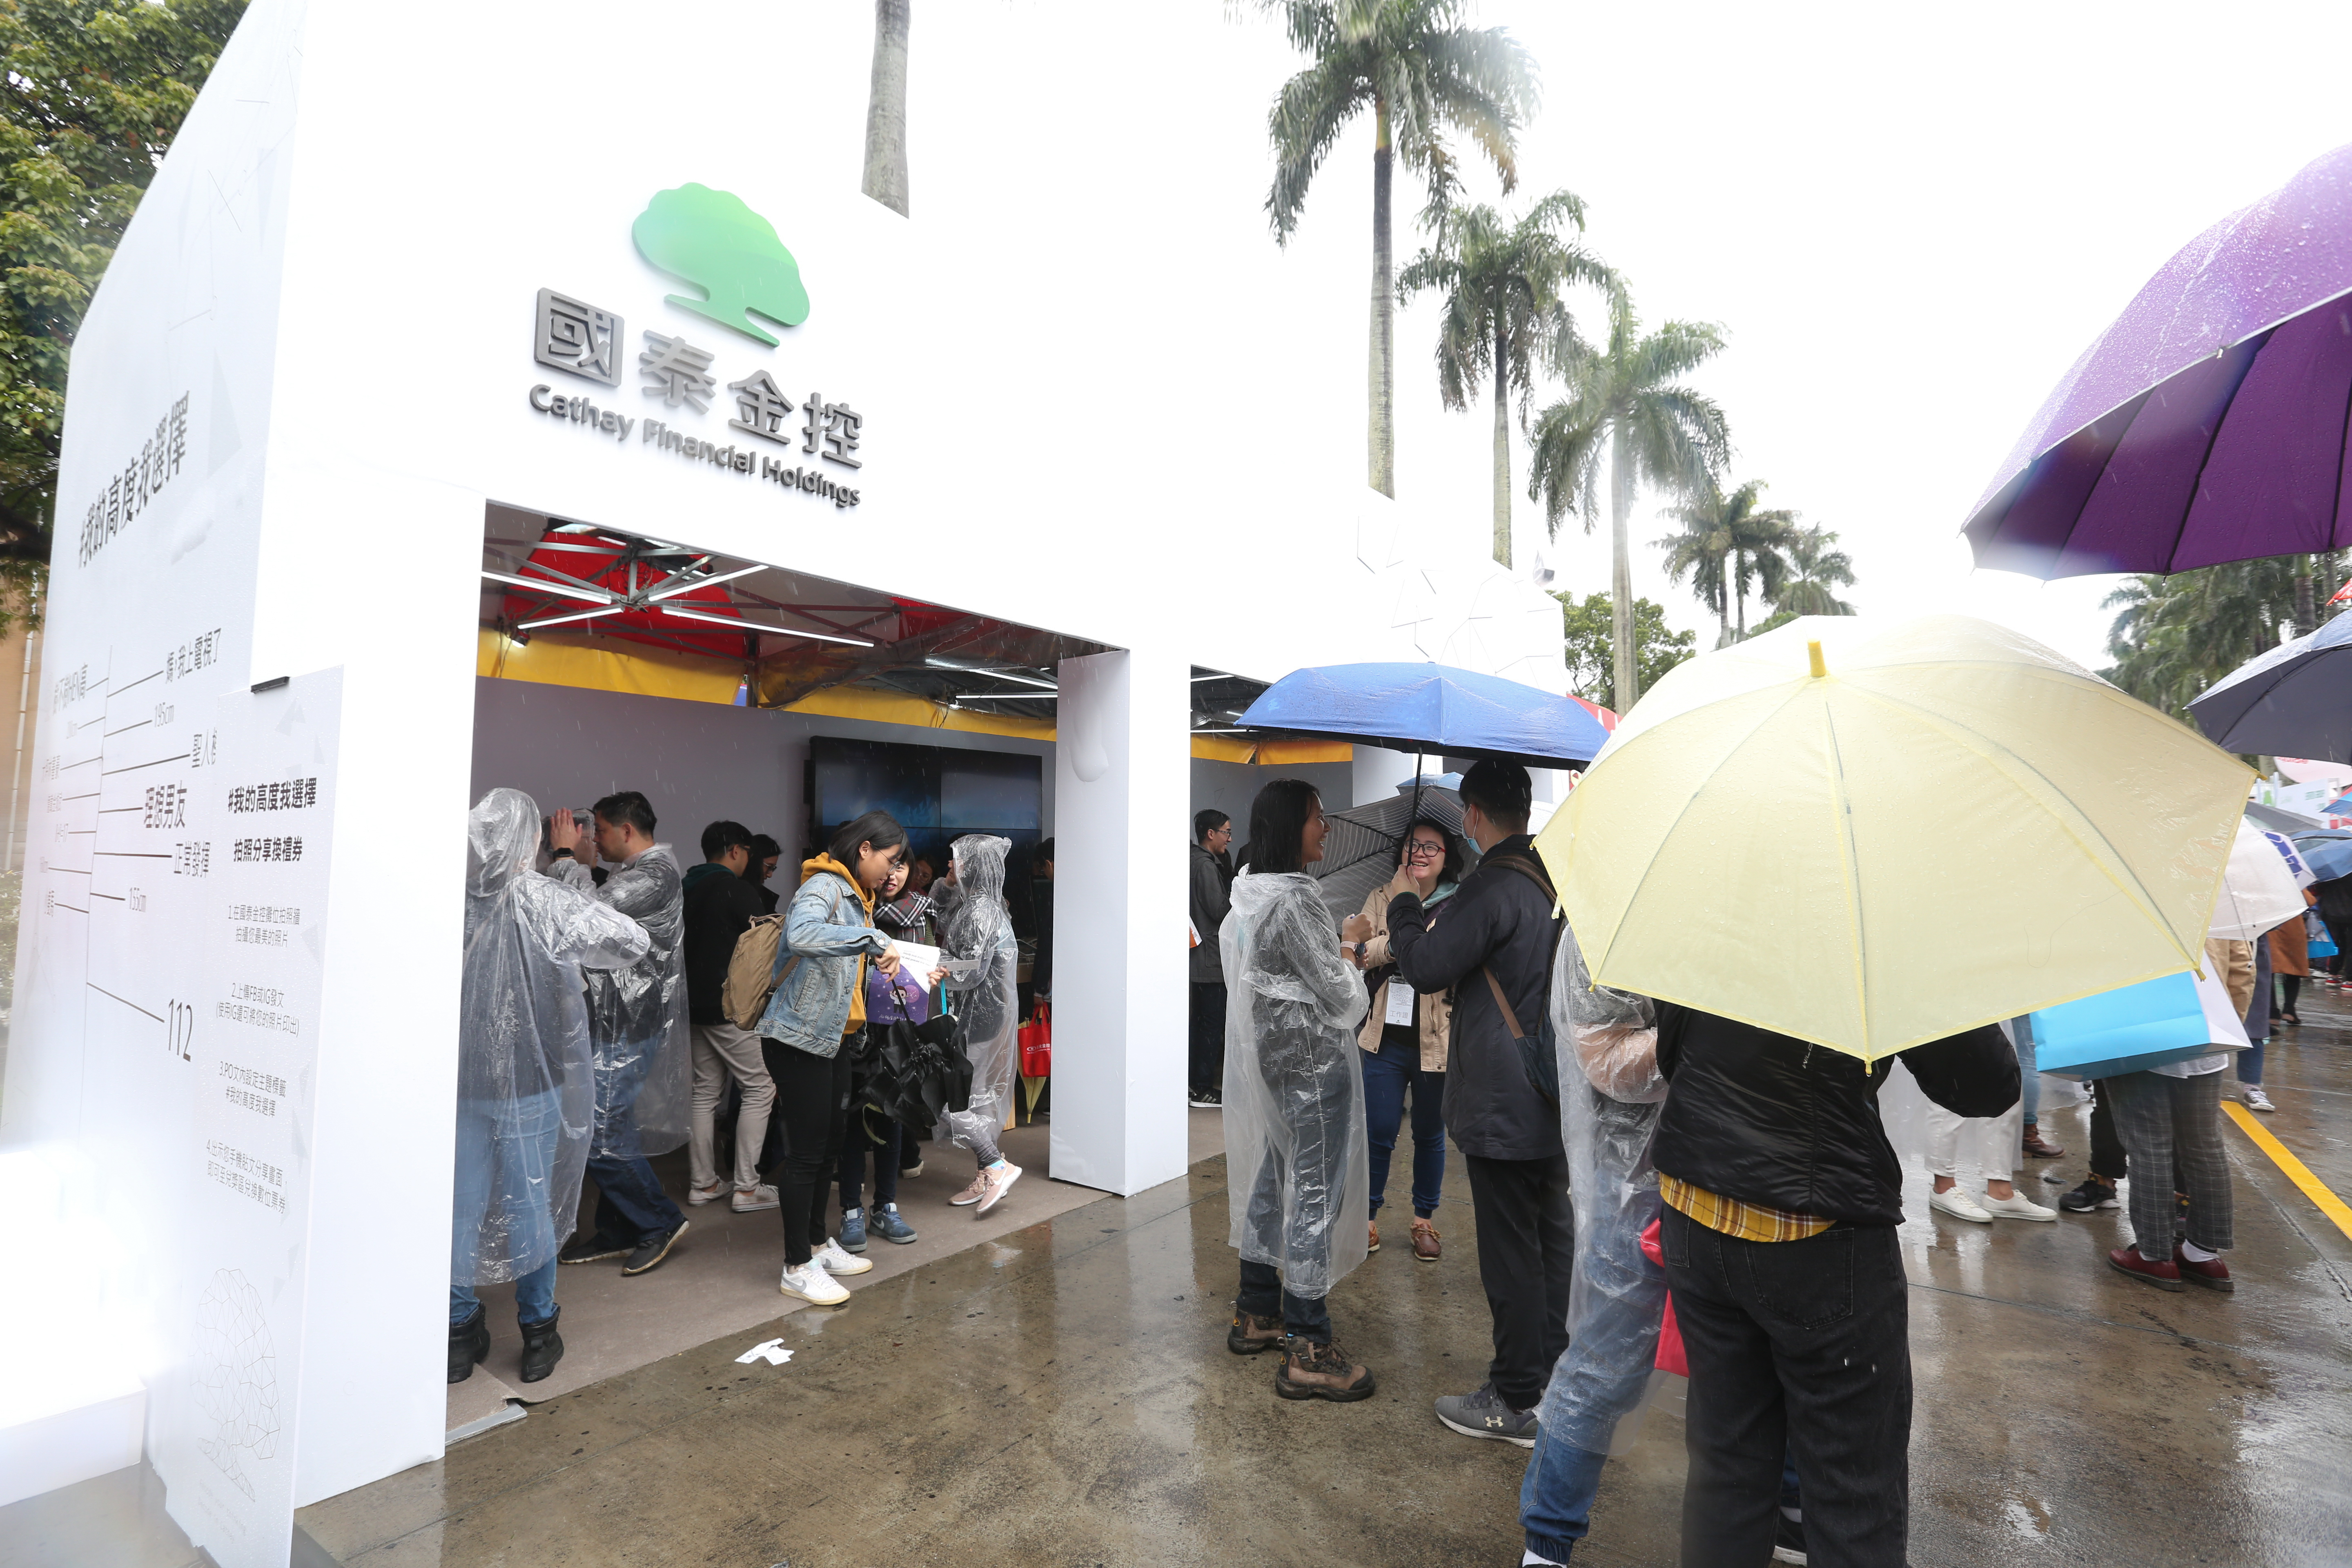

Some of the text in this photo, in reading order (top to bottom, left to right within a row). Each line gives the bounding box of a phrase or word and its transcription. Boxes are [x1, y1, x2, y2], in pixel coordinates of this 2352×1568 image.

[534, 287, 862, 469] 國泰金控
[530, 384, 861, 507] Cathay Financial Holdings
[154, 702, 174, 728] 195cm
[143, 780, 187, 829] 理想男友
[228, 777, 317, 813] #我的高度我選擇
[174, 840, 211, 878] 正常發揮
[234, 836, 303, 862] 拍照分享換禮券
[235, 926, 288, 948] 拍攝您最美的照片
[231, 982, 285, 1008] 2.上傳FB或IG發文
[168, 998, 193, 1062] 112
[1390, 1010, 1408, 1019] 工作證
[225, 1086, 276, 1118] #我的高度我選擇
